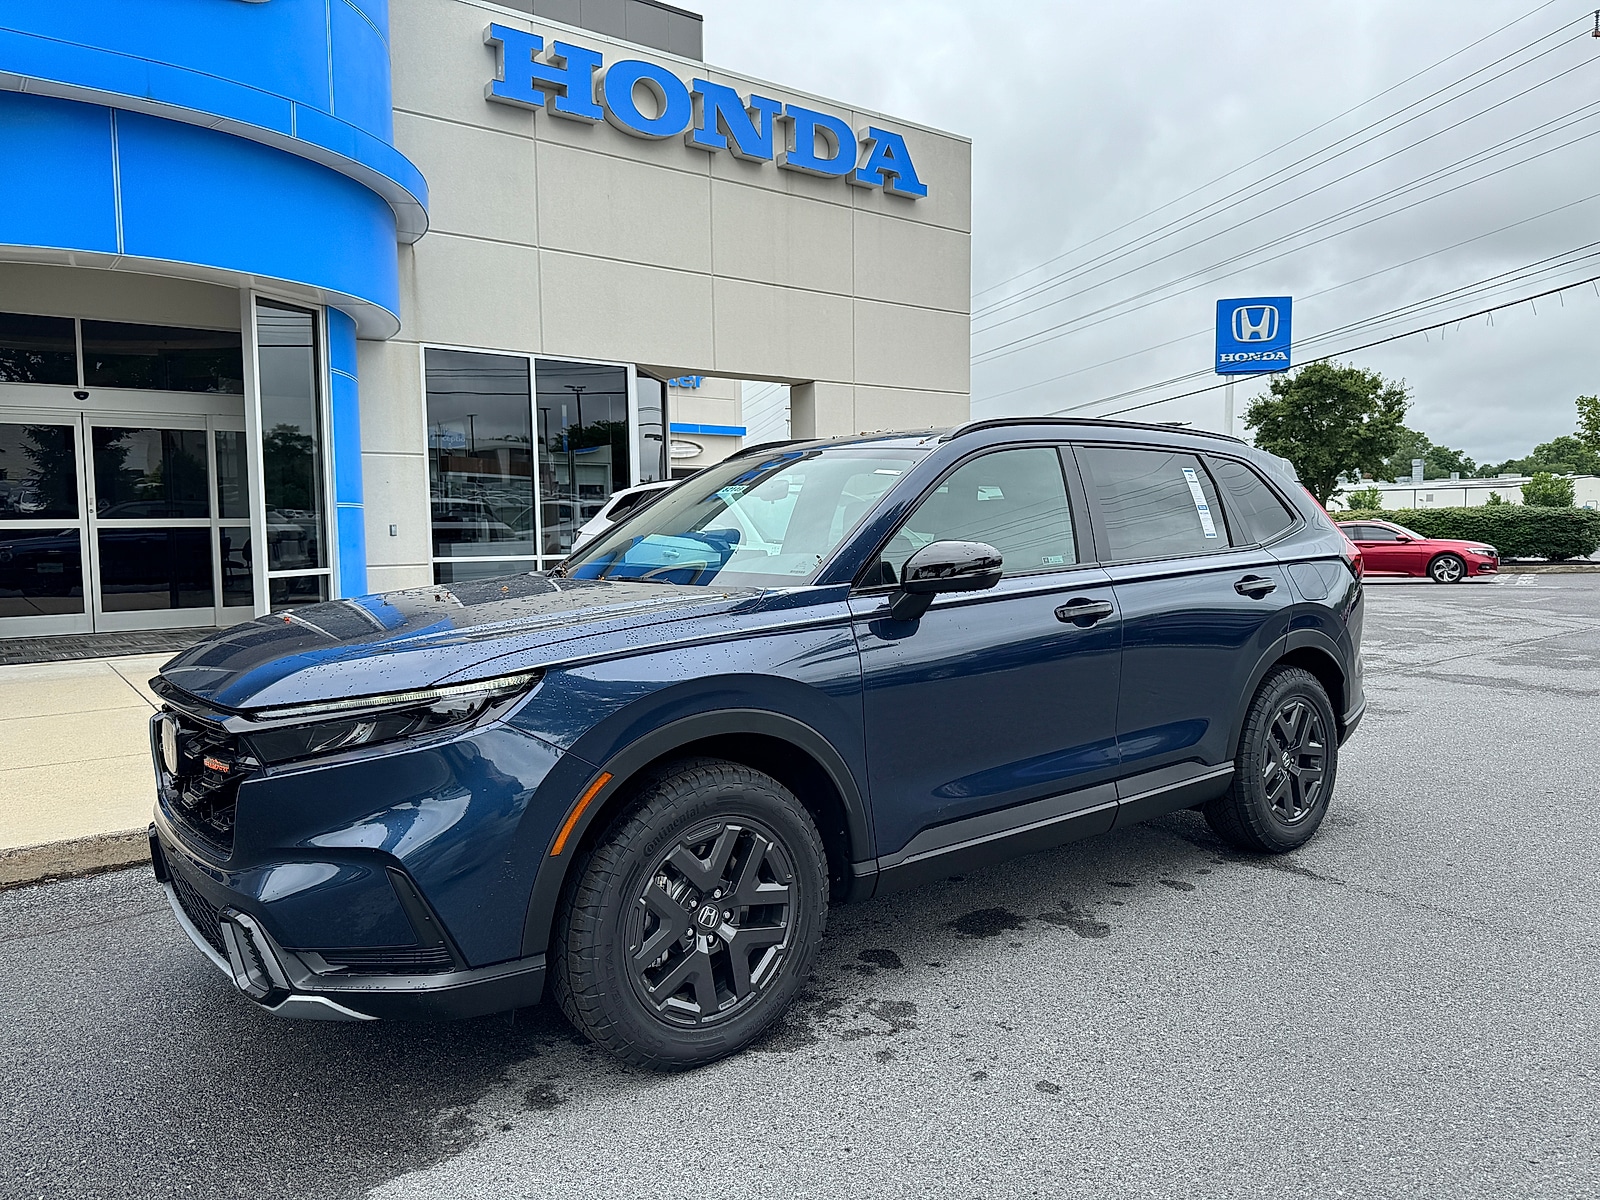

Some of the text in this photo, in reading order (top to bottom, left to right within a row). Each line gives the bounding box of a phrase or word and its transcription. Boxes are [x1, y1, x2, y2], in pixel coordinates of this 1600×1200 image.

[484, 22, 928, 199] HONDA
[1220, 351, 1289, 362] HONDA
[642, 803, 700, 858] Continental
